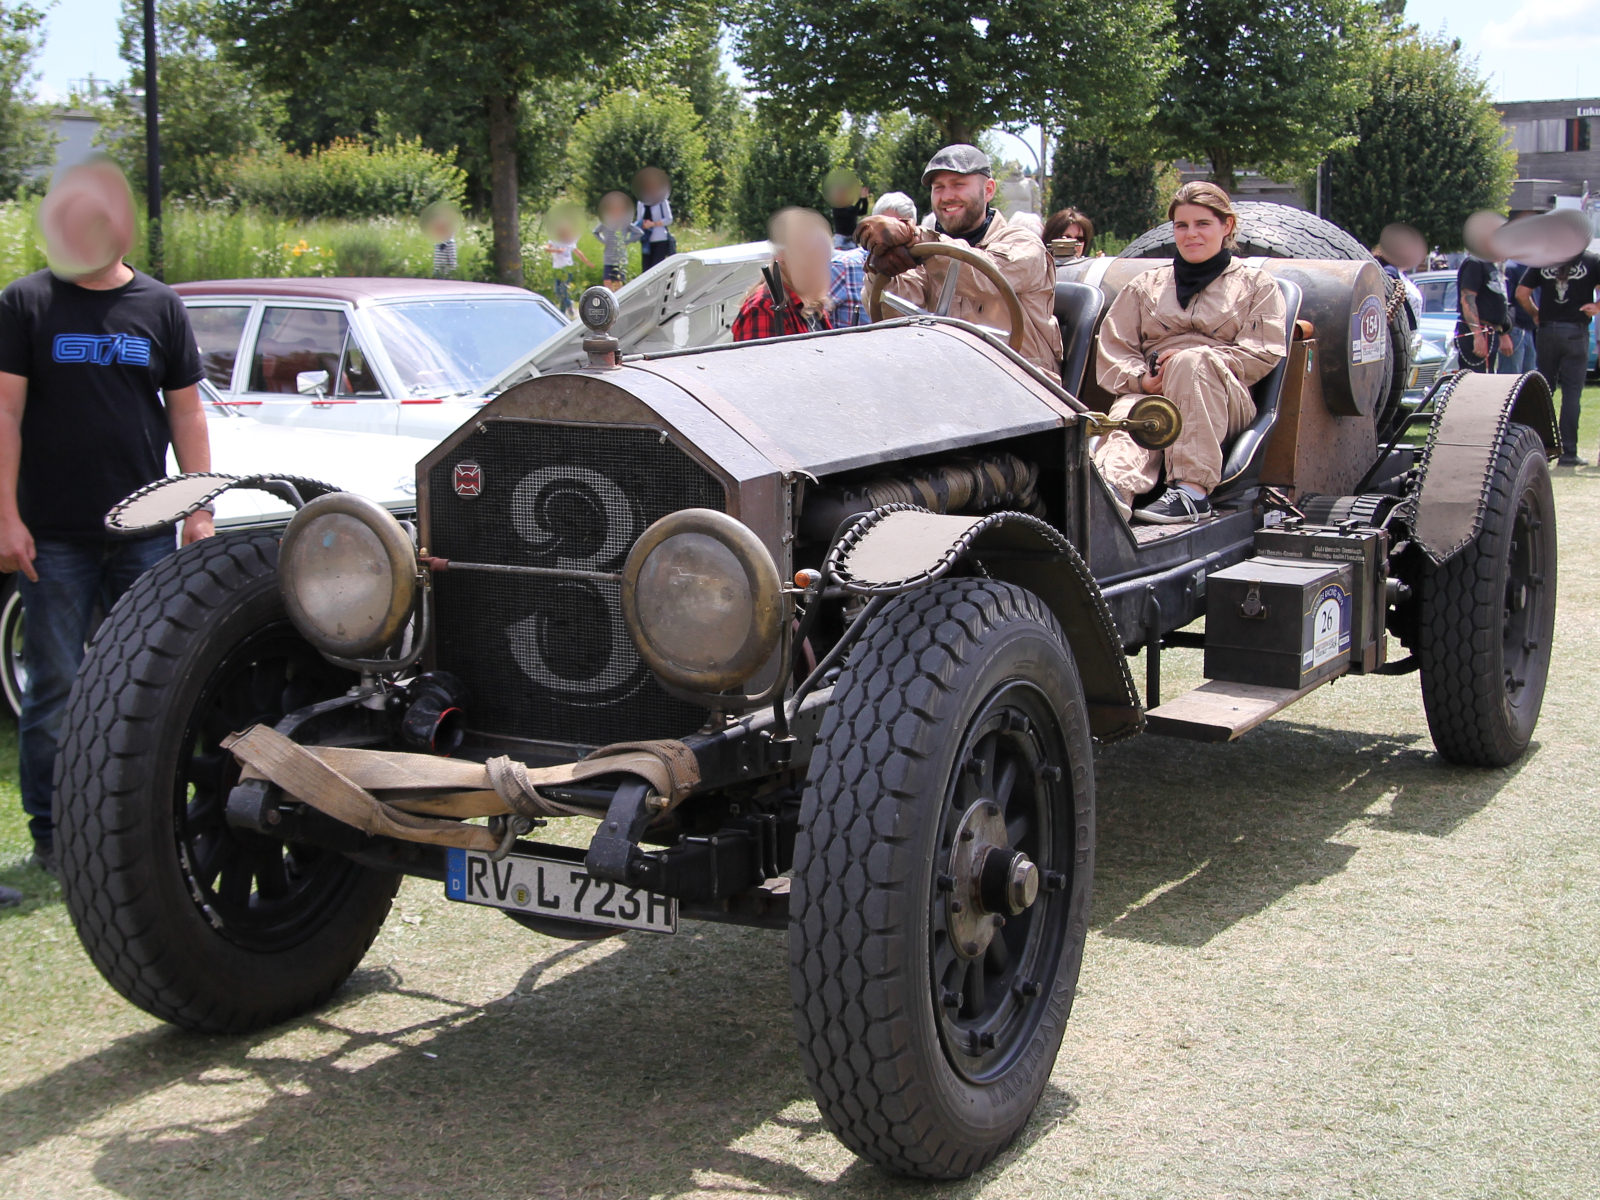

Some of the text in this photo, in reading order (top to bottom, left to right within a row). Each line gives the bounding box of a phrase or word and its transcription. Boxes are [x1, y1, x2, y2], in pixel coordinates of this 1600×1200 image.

[1365, 314, 1378, 335] 154
[52, 333, 151, 366] GT/E
[1320, 607, 1334, 634] 26
[1060, 700, 1092, 868] Goodrich
[452, 879, 461, 891] D
[467, 856, 672, 926] RV L 723H
